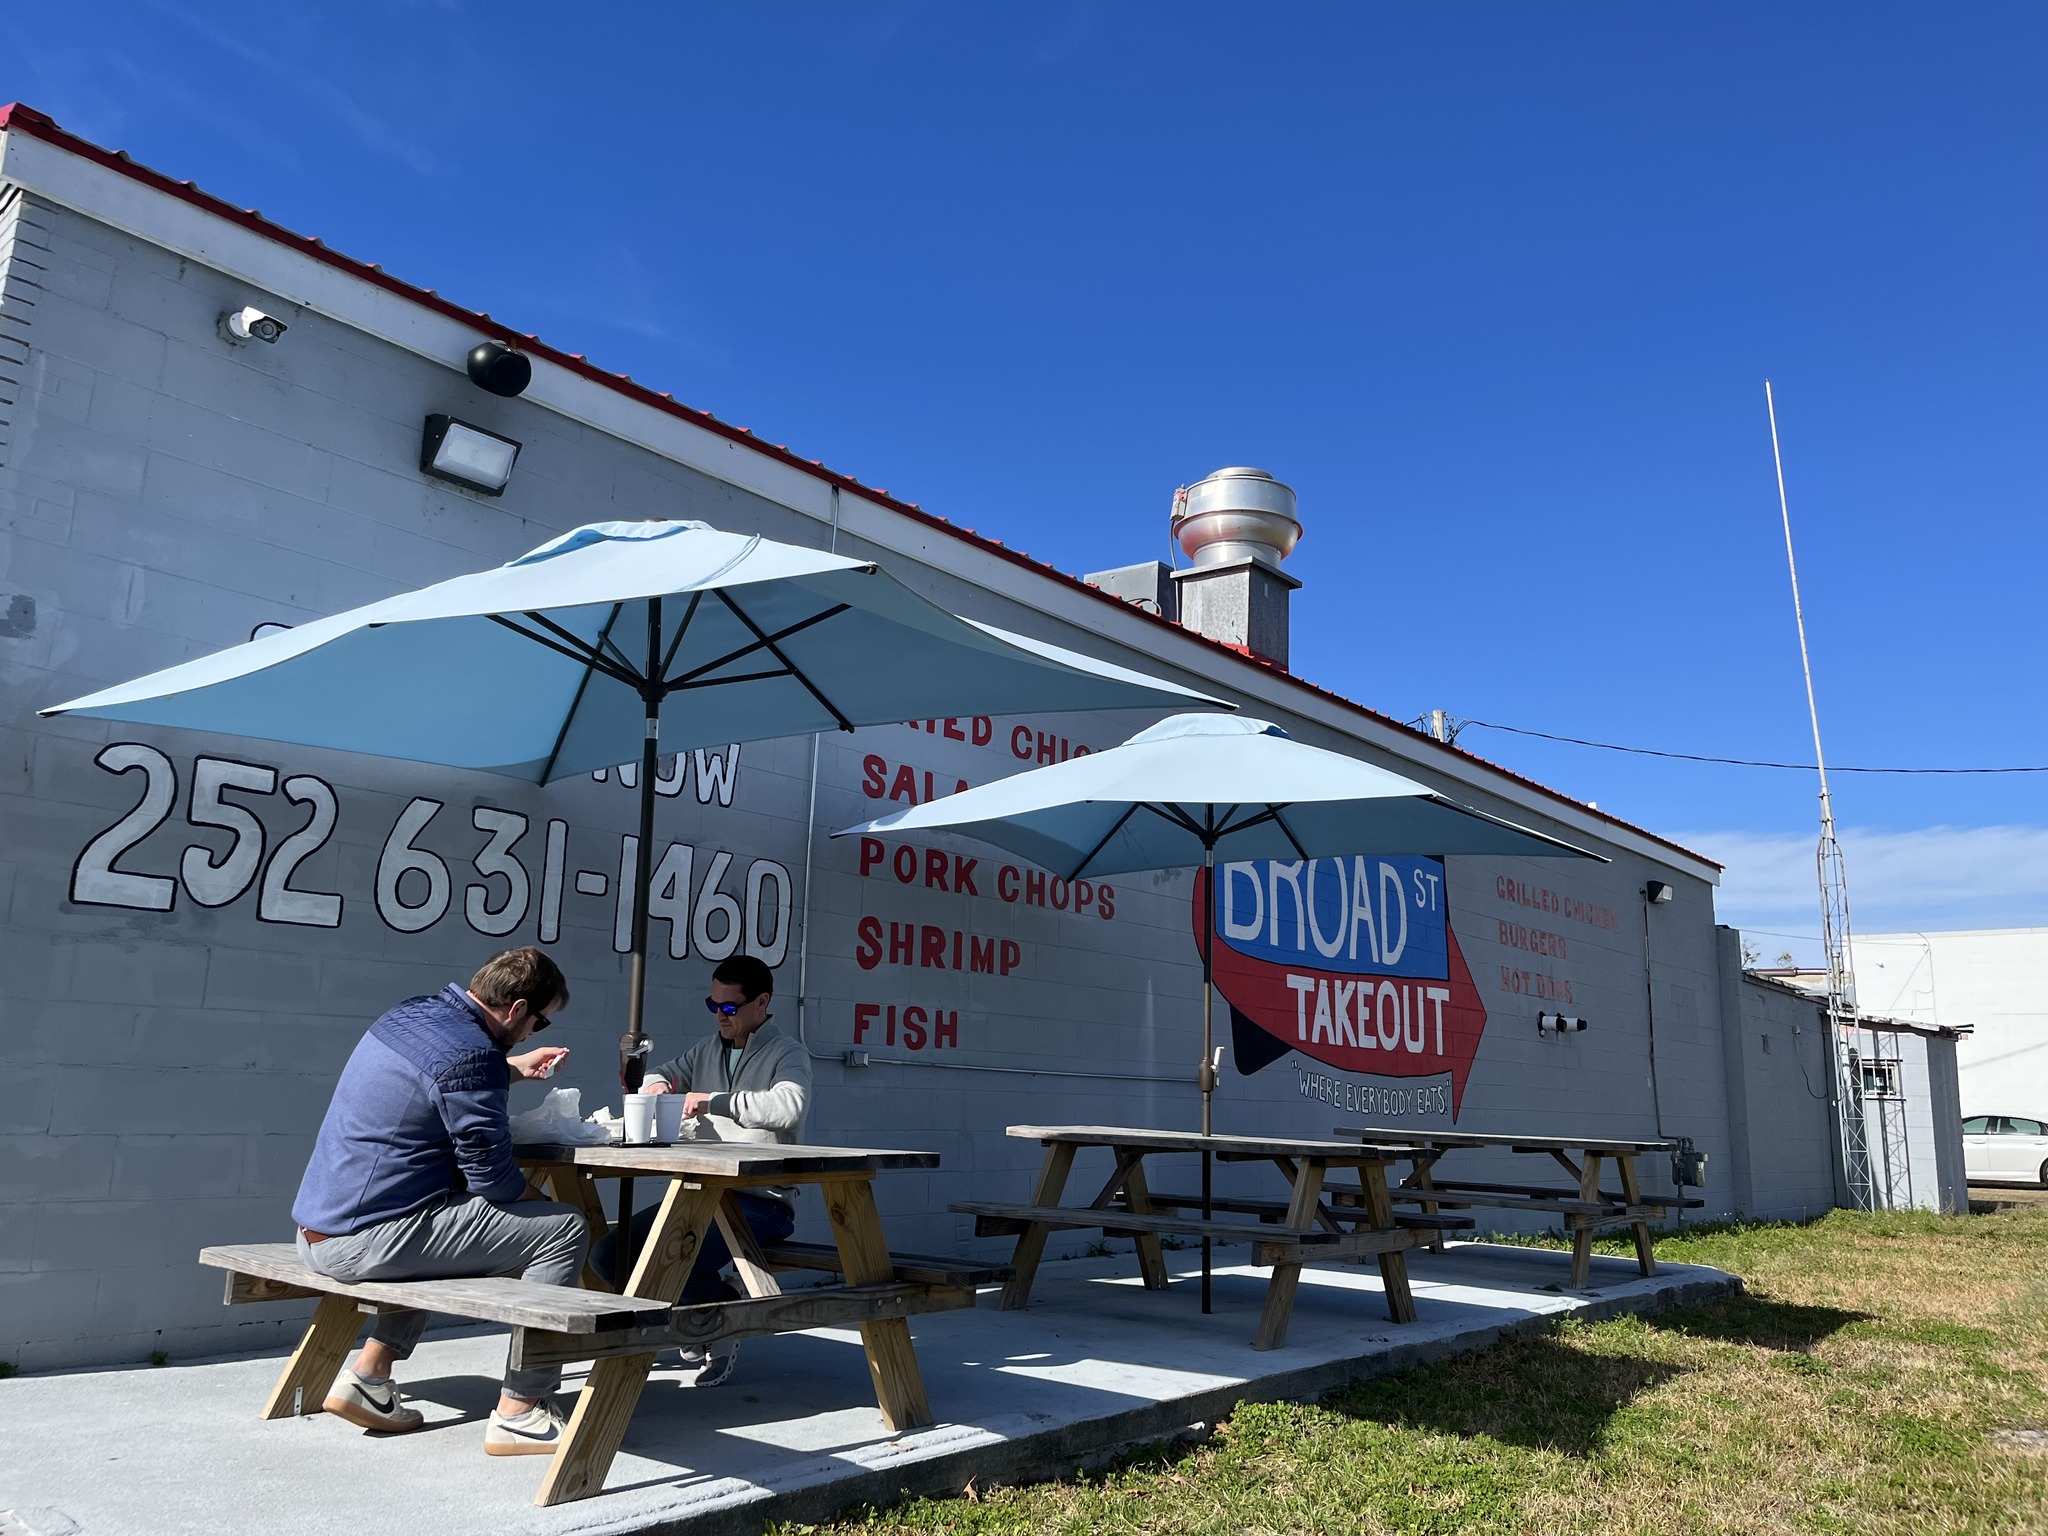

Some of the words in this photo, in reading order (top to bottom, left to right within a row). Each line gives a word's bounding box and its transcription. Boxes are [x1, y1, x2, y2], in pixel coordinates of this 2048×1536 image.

[70, 742, 343, 928] 252
[374, 796, 794, 968] 631-1460
[859, 837, 979, 896] PORK
[997, 865, 1115, 920] CHOPS
[1223, 855, 1409, 966] BROAD
[1413, 868, 1440, 912] ST
[1496, 875, 1560, 914] GRILLED
[856, 915, 1021, 977] SHRIMP
[1499, 919, 1567, 960] BURGERS
[1500, 965, 1531, 995] HOT
[853, 1003, 958, 1051] FISH
[1286, 973, 1450, 1056] TAKEOUT
[1346, 1083, 1414, 1117] EVERYBODY
